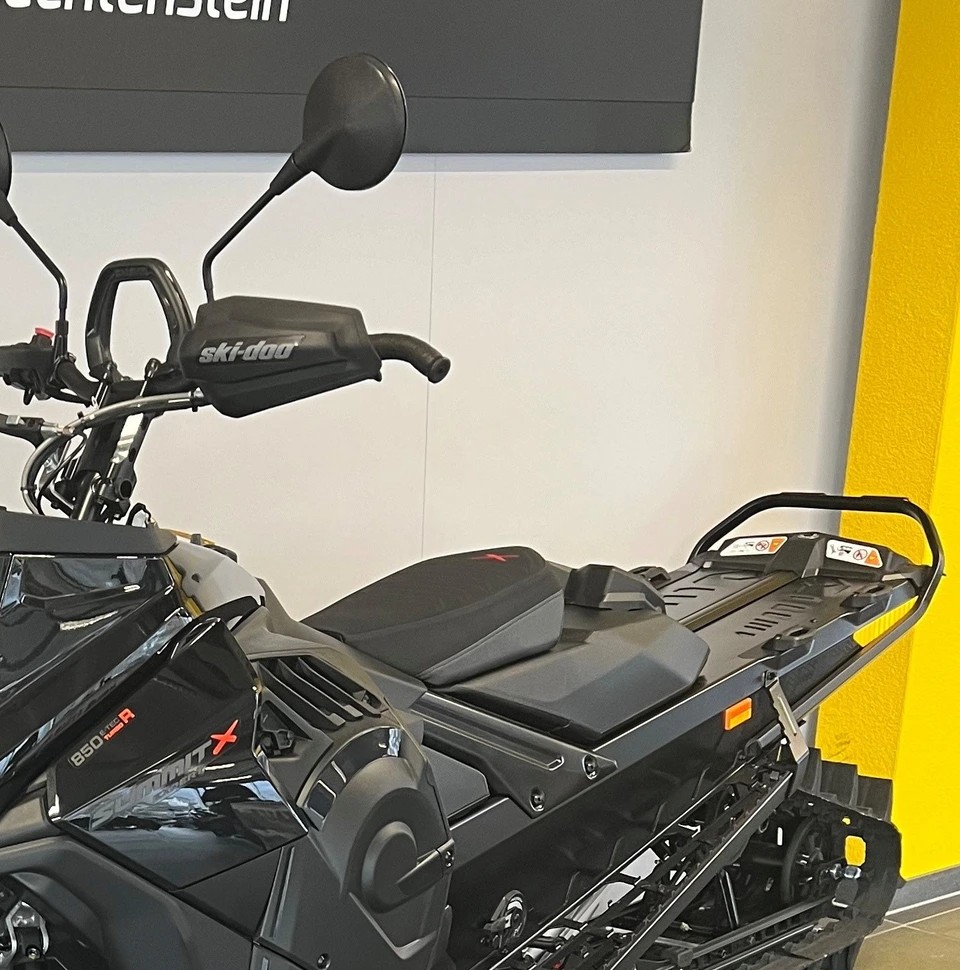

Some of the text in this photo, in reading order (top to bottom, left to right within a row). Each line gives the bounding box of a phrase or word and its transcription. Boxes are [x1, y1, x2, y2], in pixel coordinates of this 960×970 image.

[199, 340, 295, 363] ski-doo
[71, 735, 103, 767] 850
[118, 708, 135, 724] R
[91, 719, 238, 831] SUMMIT X
